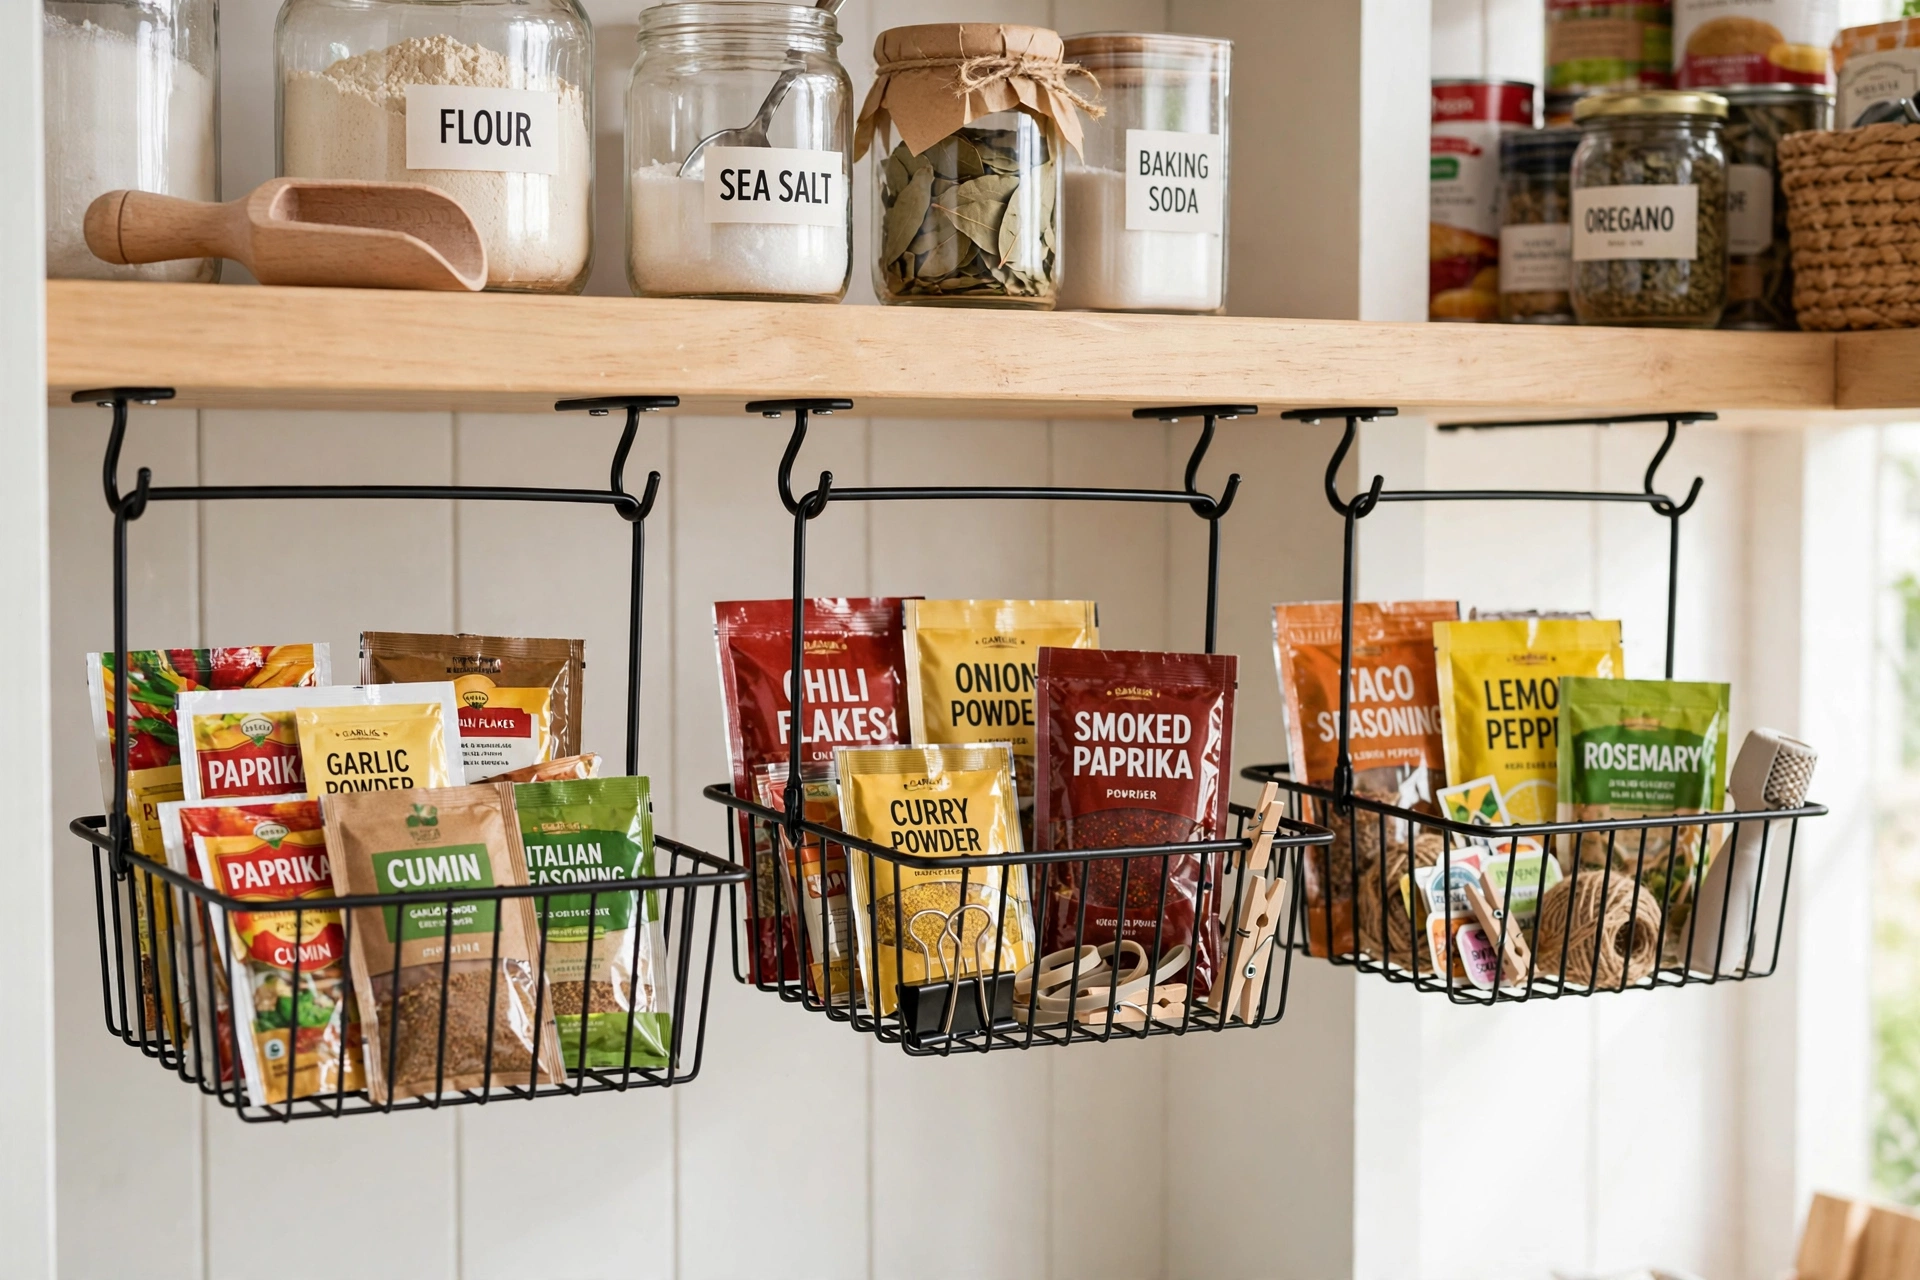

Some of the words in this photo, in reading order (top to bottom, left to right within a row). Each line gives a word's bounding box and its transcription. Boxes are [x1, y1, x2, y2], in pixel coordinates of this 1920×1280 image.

[440, 108, 532, 148] FLOUR
[1138, 149, 1210, 181] BAKING
[719, 168, 771, 202] SEA
[778, 172, 832, 206] SALT
[1148, 186, 1200, 214] SODA
[1584, 205, 1675, 234] OREGANO
[955, 662, 1037, 694] ONION
[1484, 677, 1562, 711] LEMO
[951, 699, 1036, 727] POWDE
[1073, 710, 1192, 744] SMOKED
[326, 749, 410, 776] GARLIC
[1073, 746, 1194, 780] PAPRIKA
[1584, 741, 1703, 774] ROSEMARY
[890, 797, 970, 827] CURRY
[526, 842, 603, 867] ITALIAN
[890, 827, 983, 854] POWDER
[386, 852, 482, 889] CUMIN
[273, 941, 332, 966] CUMIN
